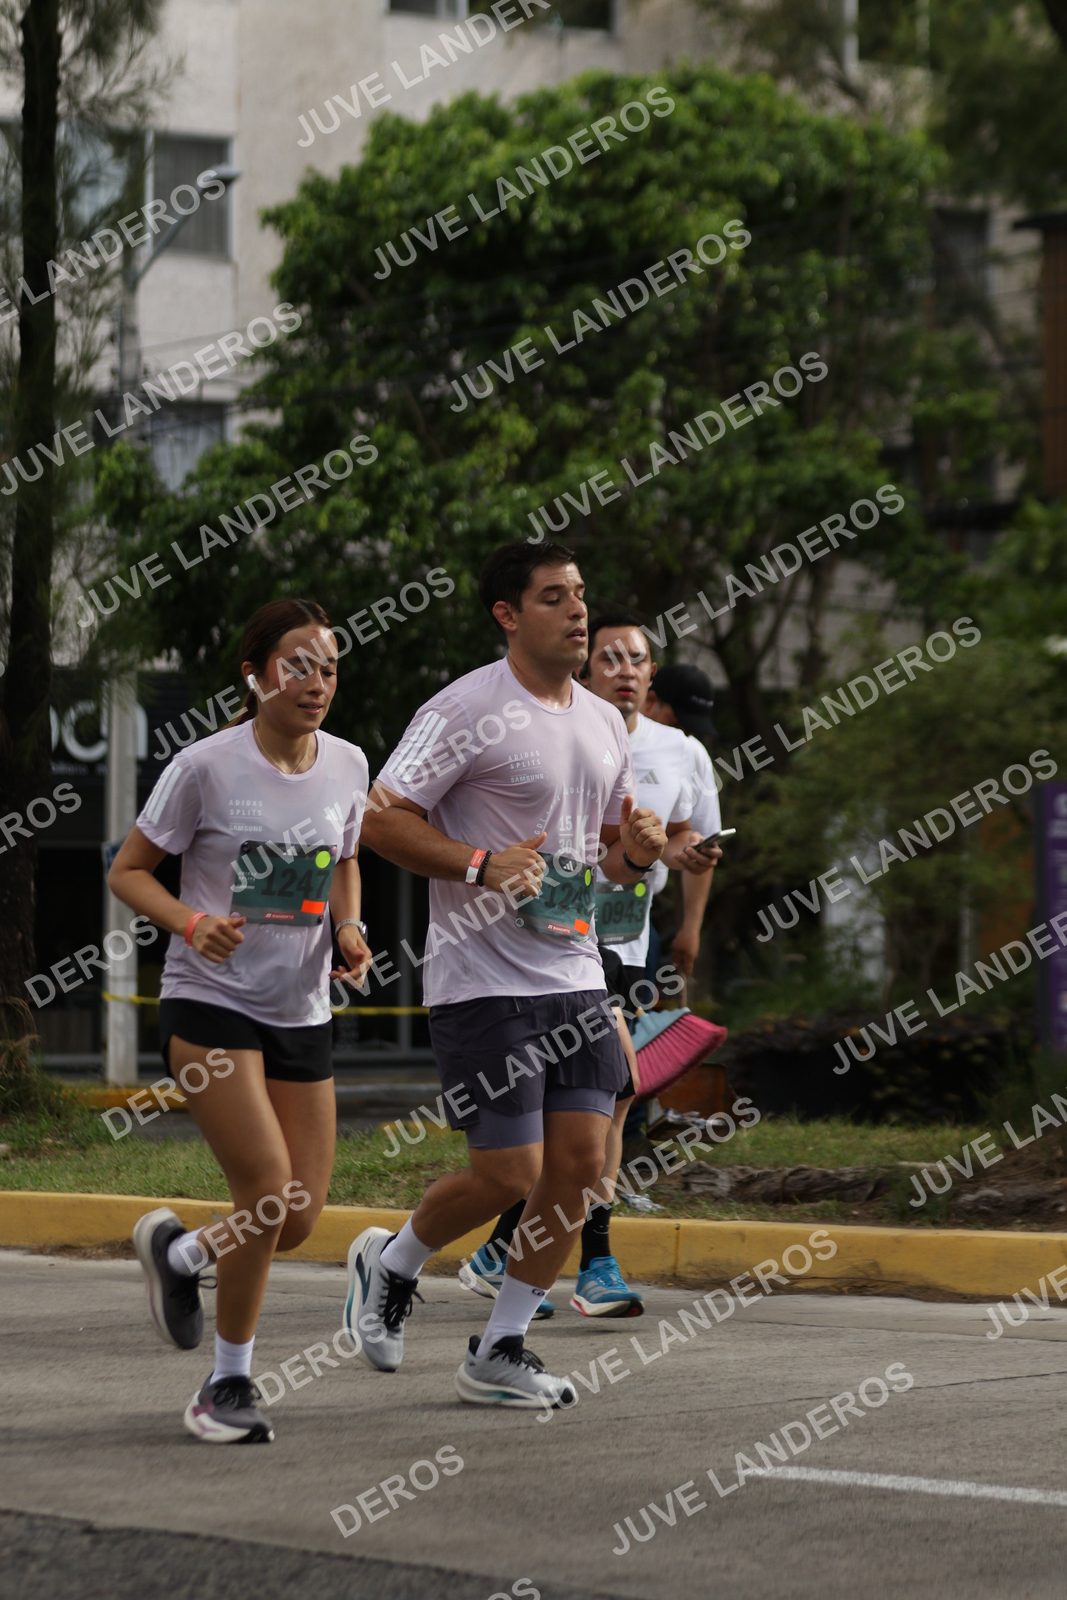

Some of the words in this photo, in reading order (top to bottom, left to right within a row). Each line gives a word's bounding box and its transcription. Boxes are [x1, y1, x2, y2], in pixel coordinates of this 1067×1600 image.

[229, 808, 262, 816] SPLITS
[559, 815, 573, 831] 15
[261, 867, 330, 899] 1247
[602, 900, 645, 925] 0943
